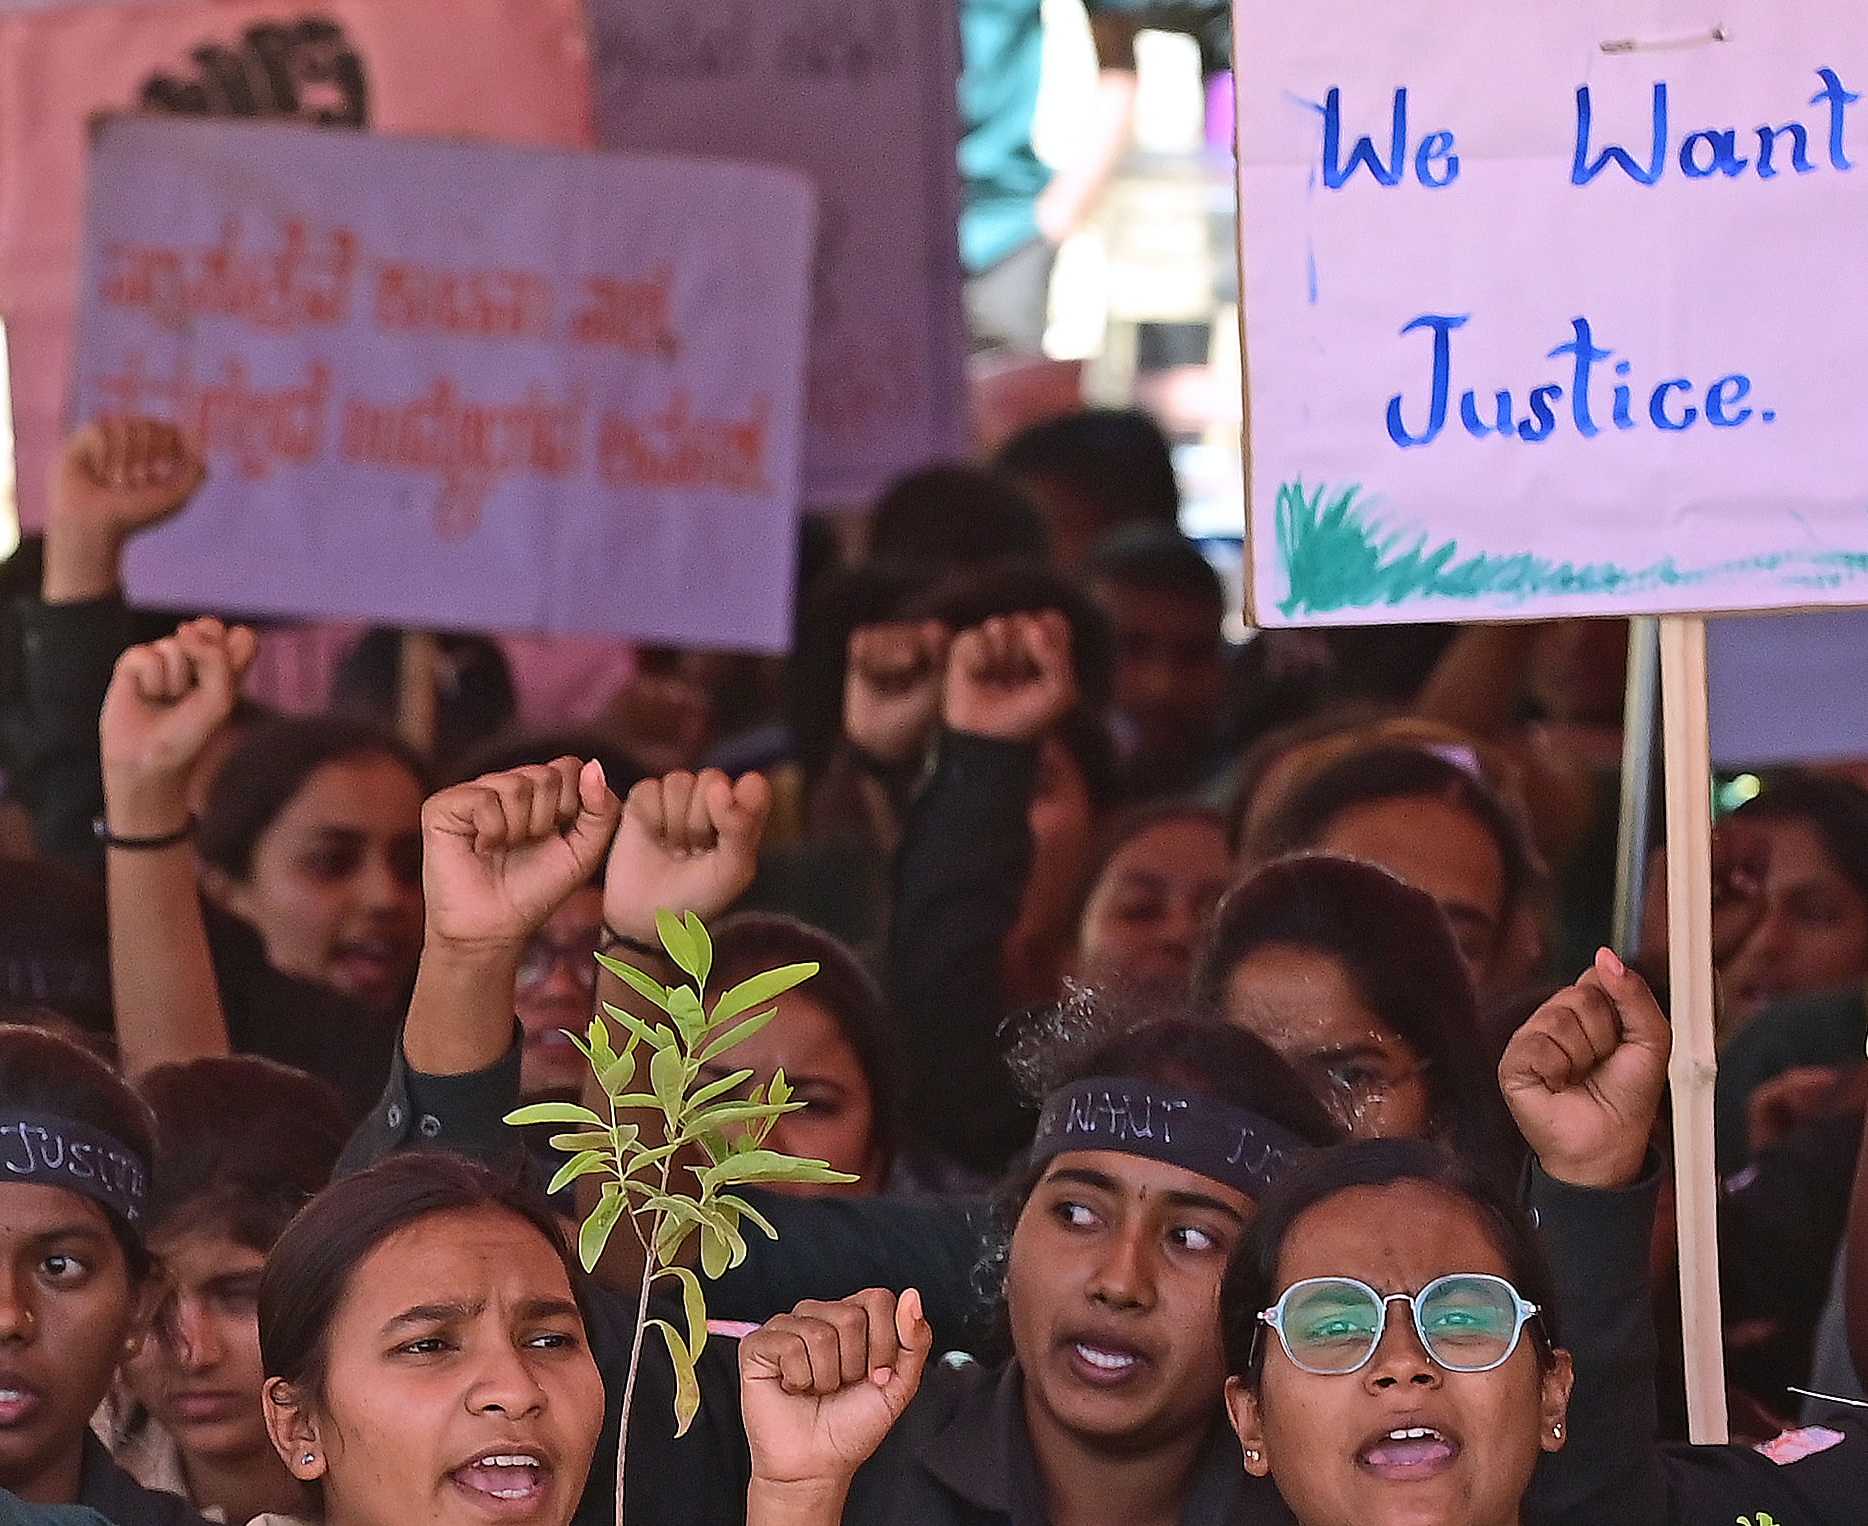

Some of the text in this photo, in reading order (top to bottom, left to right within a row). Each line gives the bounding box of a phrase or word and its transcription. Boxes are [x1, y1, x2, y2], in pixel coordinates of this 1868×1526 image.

[1320, 67, 1862, 190] We Want
[1385, 314, 1777, 448] Justice.
